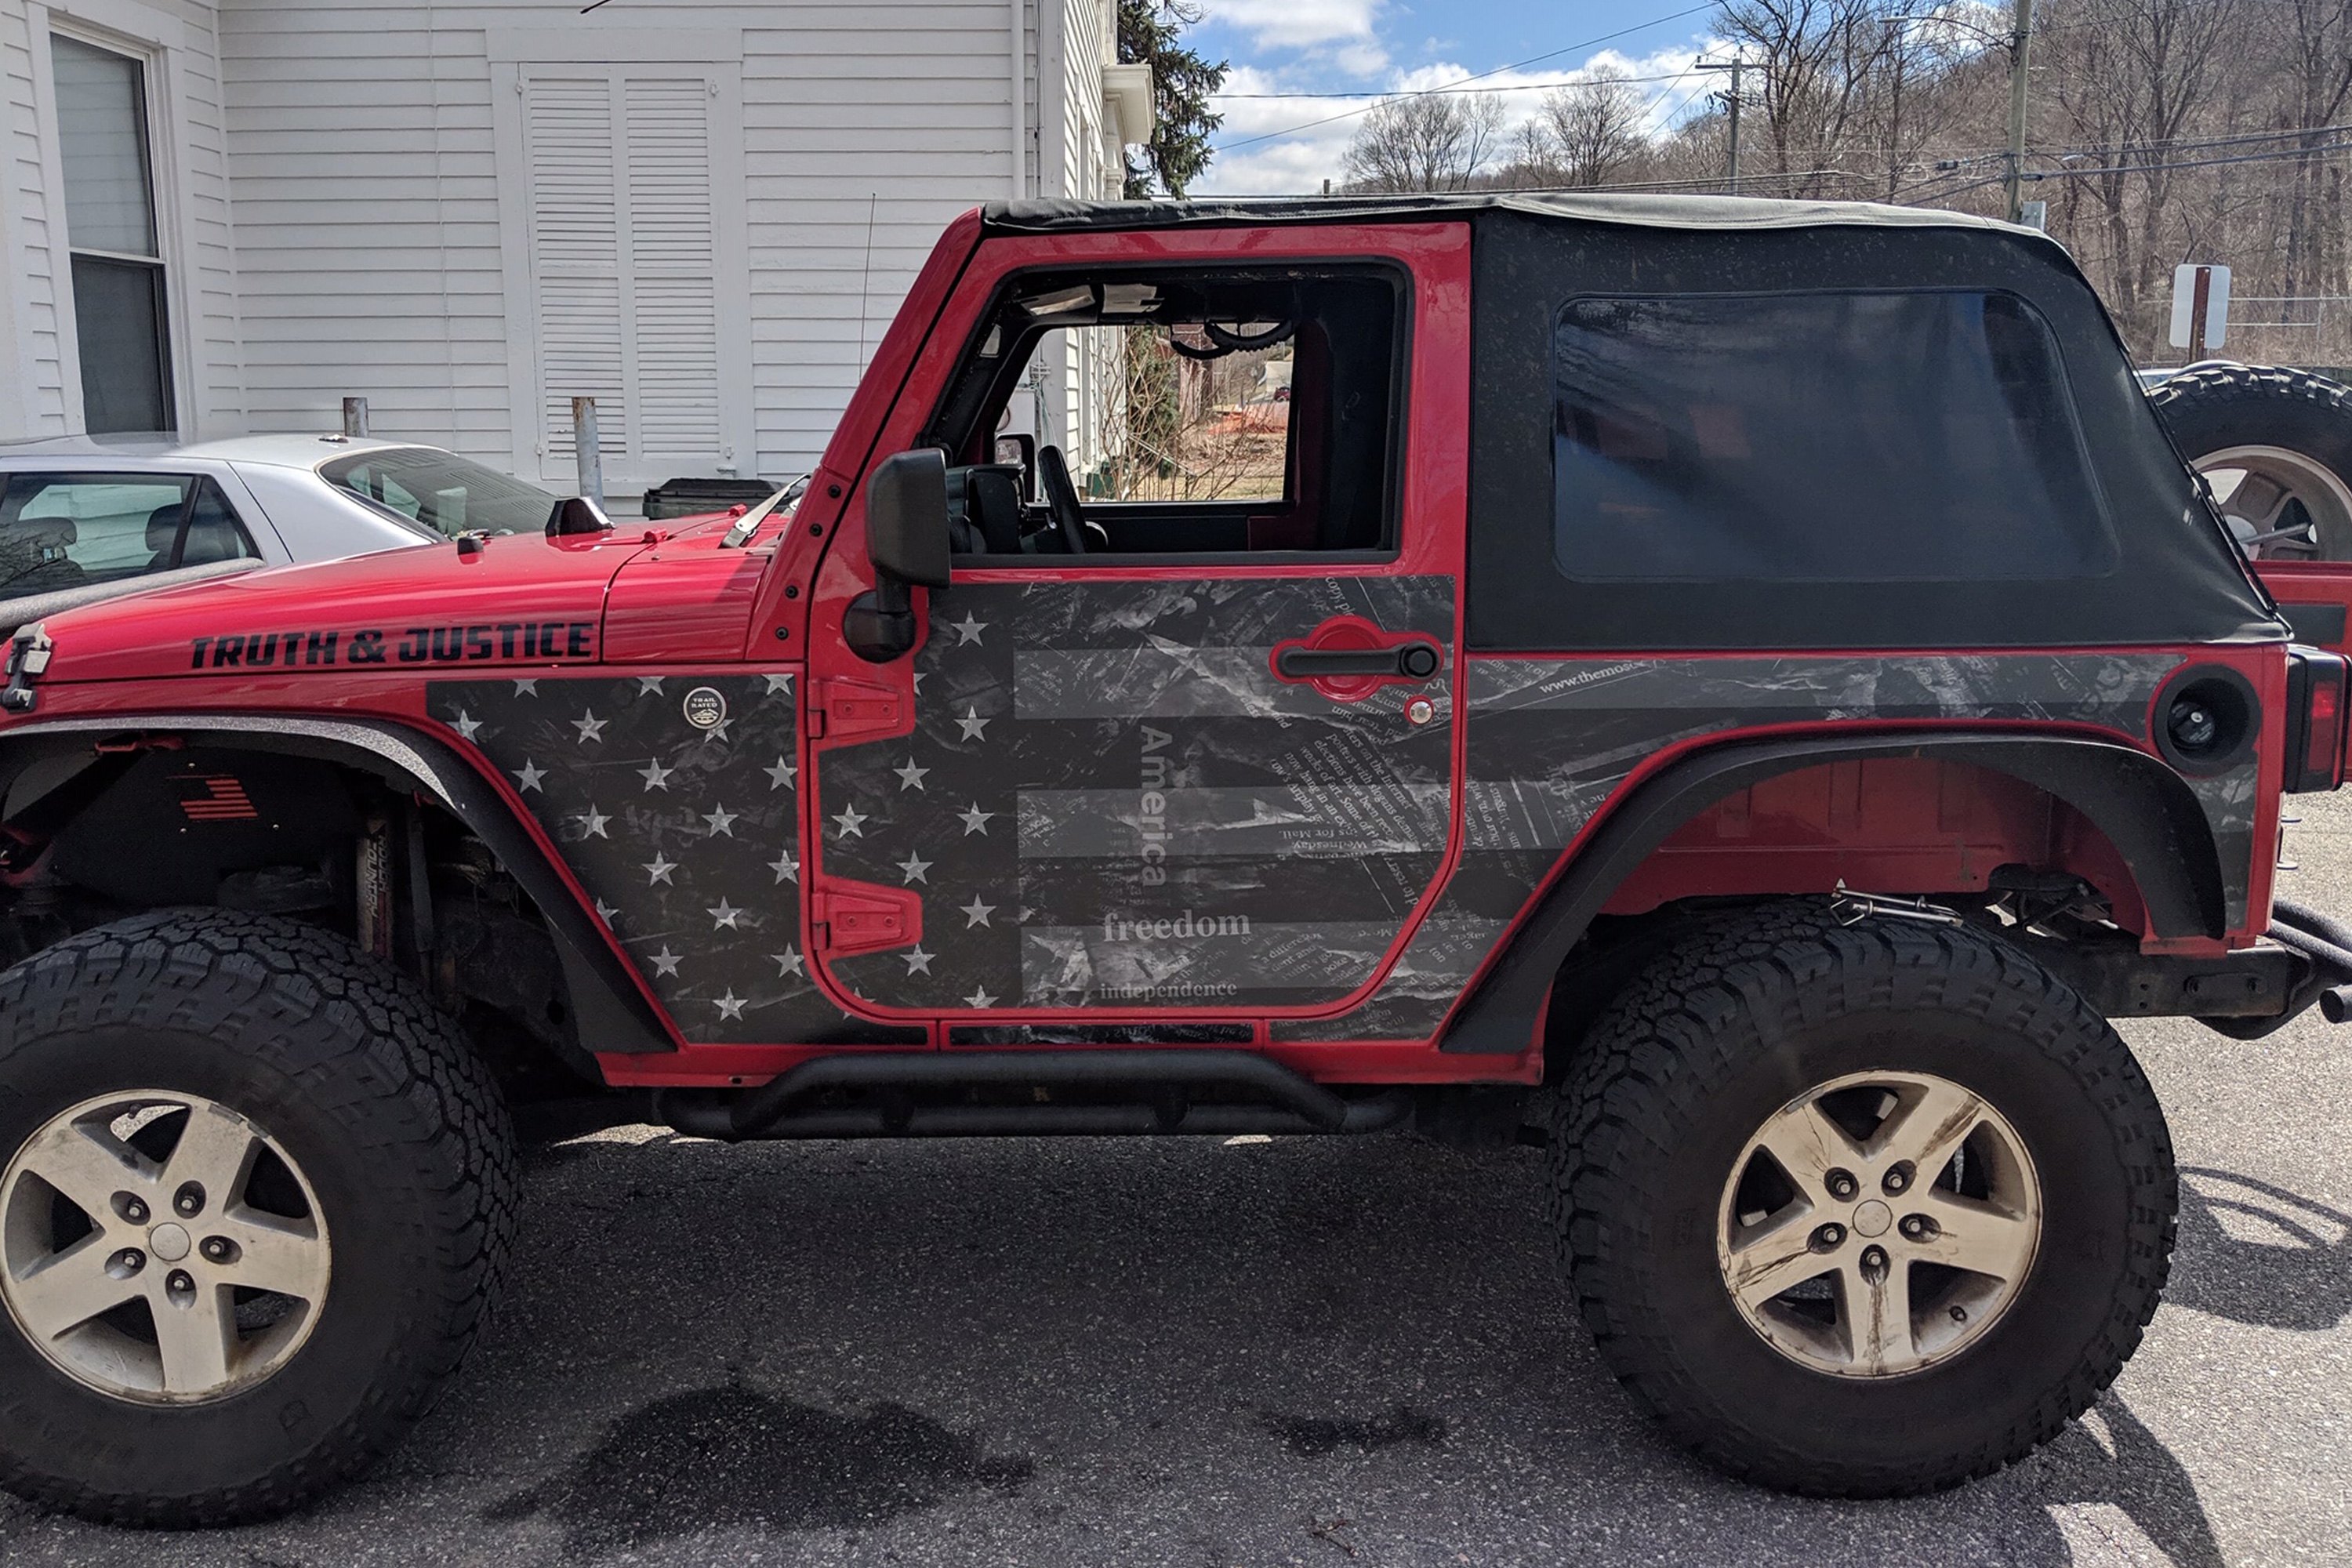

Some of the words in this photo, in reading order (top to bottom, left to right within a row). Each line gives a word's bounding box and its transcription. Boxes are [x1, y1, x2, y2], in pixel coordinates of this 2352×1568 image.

[191, 632, 339, 669] TRUTH
[348, 629, 387, 664] &
[398, 622, 594, 662] JUSTICE
[1284, 752, 1302, 771] now
[1299, 769, 1320, 795] hang
[1316, 790, 1329, 805] in
[1324, 803, 1338, 816] an
[1300, 746, 1322, 773] works
[1319, 771, 1335, 782] of
[1340, 797, 1363, 824] Some
[1314, 739, 1346, 777] elections
[1343, 775, 1363, 797] have
[1359, 794, 1380, 819] been
[1325, 733, 1356, 764] posters
[1354, 762, 1373, 785] with
[1370, 783, 1396, 815] slogans
[1371, 757, 1385, 778] the
[1141, 725, 1173, 886] America
[365, 838, 379, 918] COUNTRY
[378, 834, 388, 892] ROUGH
[1103, 909, 1250, 942] freedom
[1101, 982, 1237, 1001] independence
